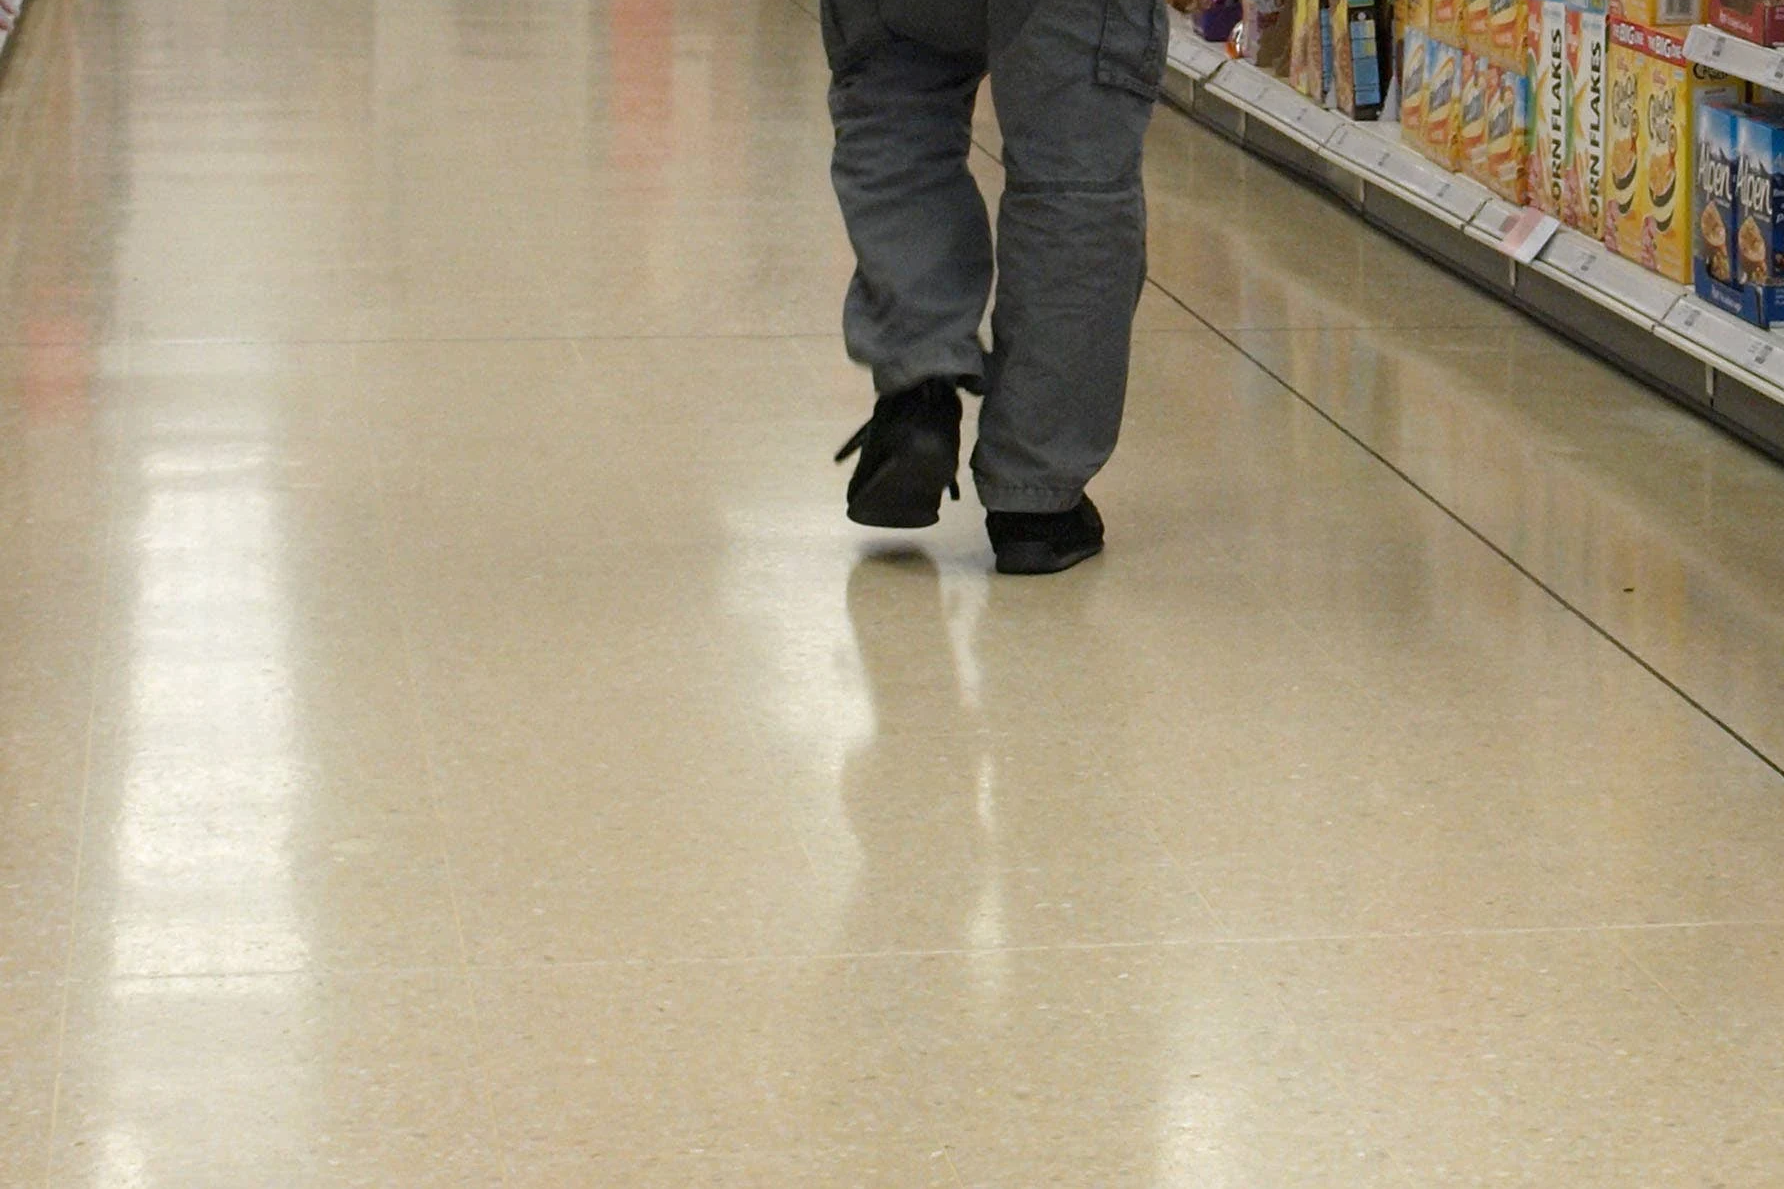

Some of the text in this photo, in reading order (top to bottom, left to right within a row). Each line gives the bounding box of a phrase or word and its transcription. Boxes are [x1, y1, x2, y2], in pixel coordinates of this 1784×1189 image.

[1551, 27, 1563, 140] FLAKES
[1589, 40, 1602, 149] FLAKES
[1699, 141, 1732, 202] Alpen
[1736, 155, 1773, 216] Alpen
